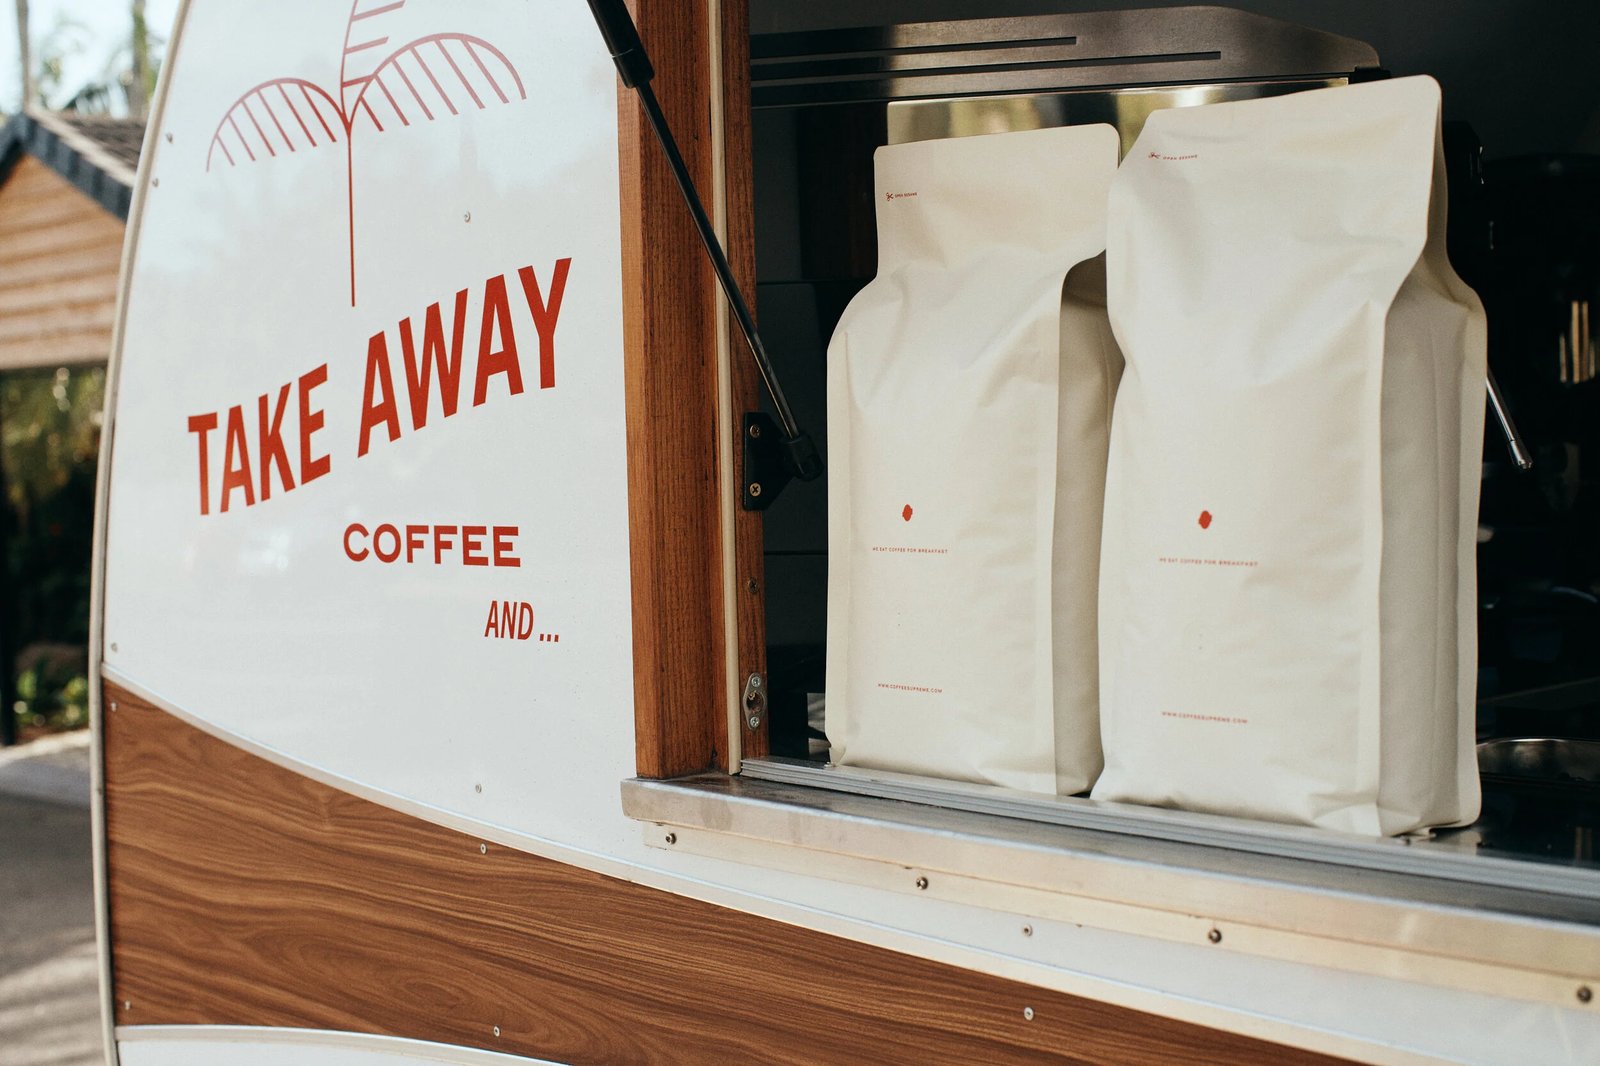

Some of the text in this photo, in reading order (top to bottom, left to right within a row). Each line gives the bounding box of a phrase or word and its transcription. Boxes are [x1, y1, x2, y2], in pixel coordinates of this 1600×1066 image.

[187, 257, 572, 516] TAKE AWAY
[343, 523, 521, 568] COFFEE
[918, 547, 948, 555] BREAKFAST
[1218, 559, 1258, 567] BREAKFAST
